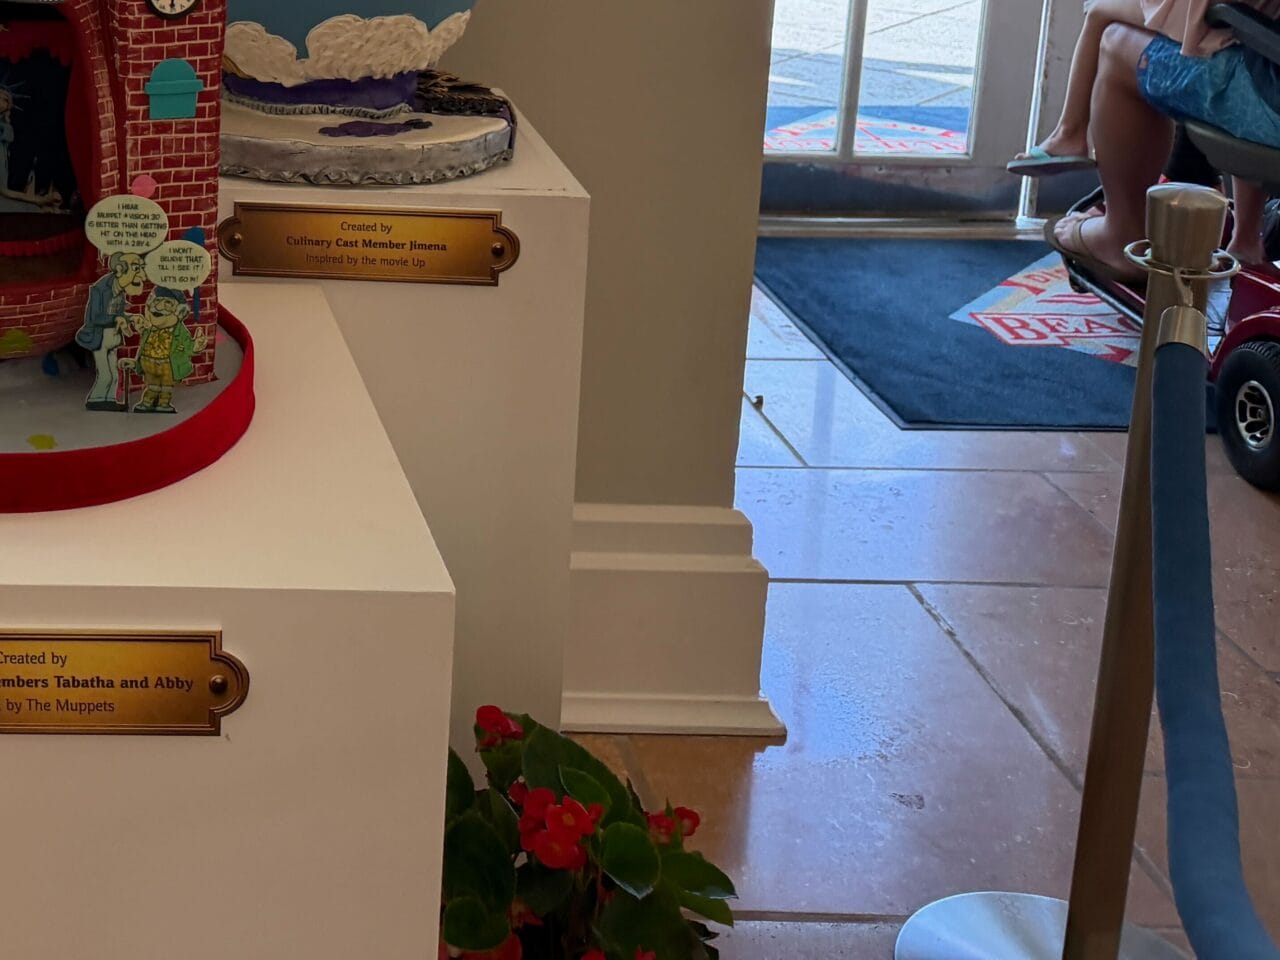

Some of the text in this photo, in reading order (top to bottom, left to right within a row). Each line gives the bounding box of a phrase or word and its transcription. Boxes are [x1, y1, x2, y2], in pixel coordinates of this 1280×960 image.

[340, 221, 392, 234] Created by
[286, 236, 447, 251] Culinary Cast Member Jimena
[306, 253, 426, 268] Inspired by the movie Up
[51, 652, 67, 667] by
[54, 675, 114, 689] Tabatha
[120, 676, 149, 689] and
[154, 676, 194, 691] Abby
[6, 698, 22, 714] by
[26, 698, 51, 711] The
[55, 699, 115, 715] Muppets
